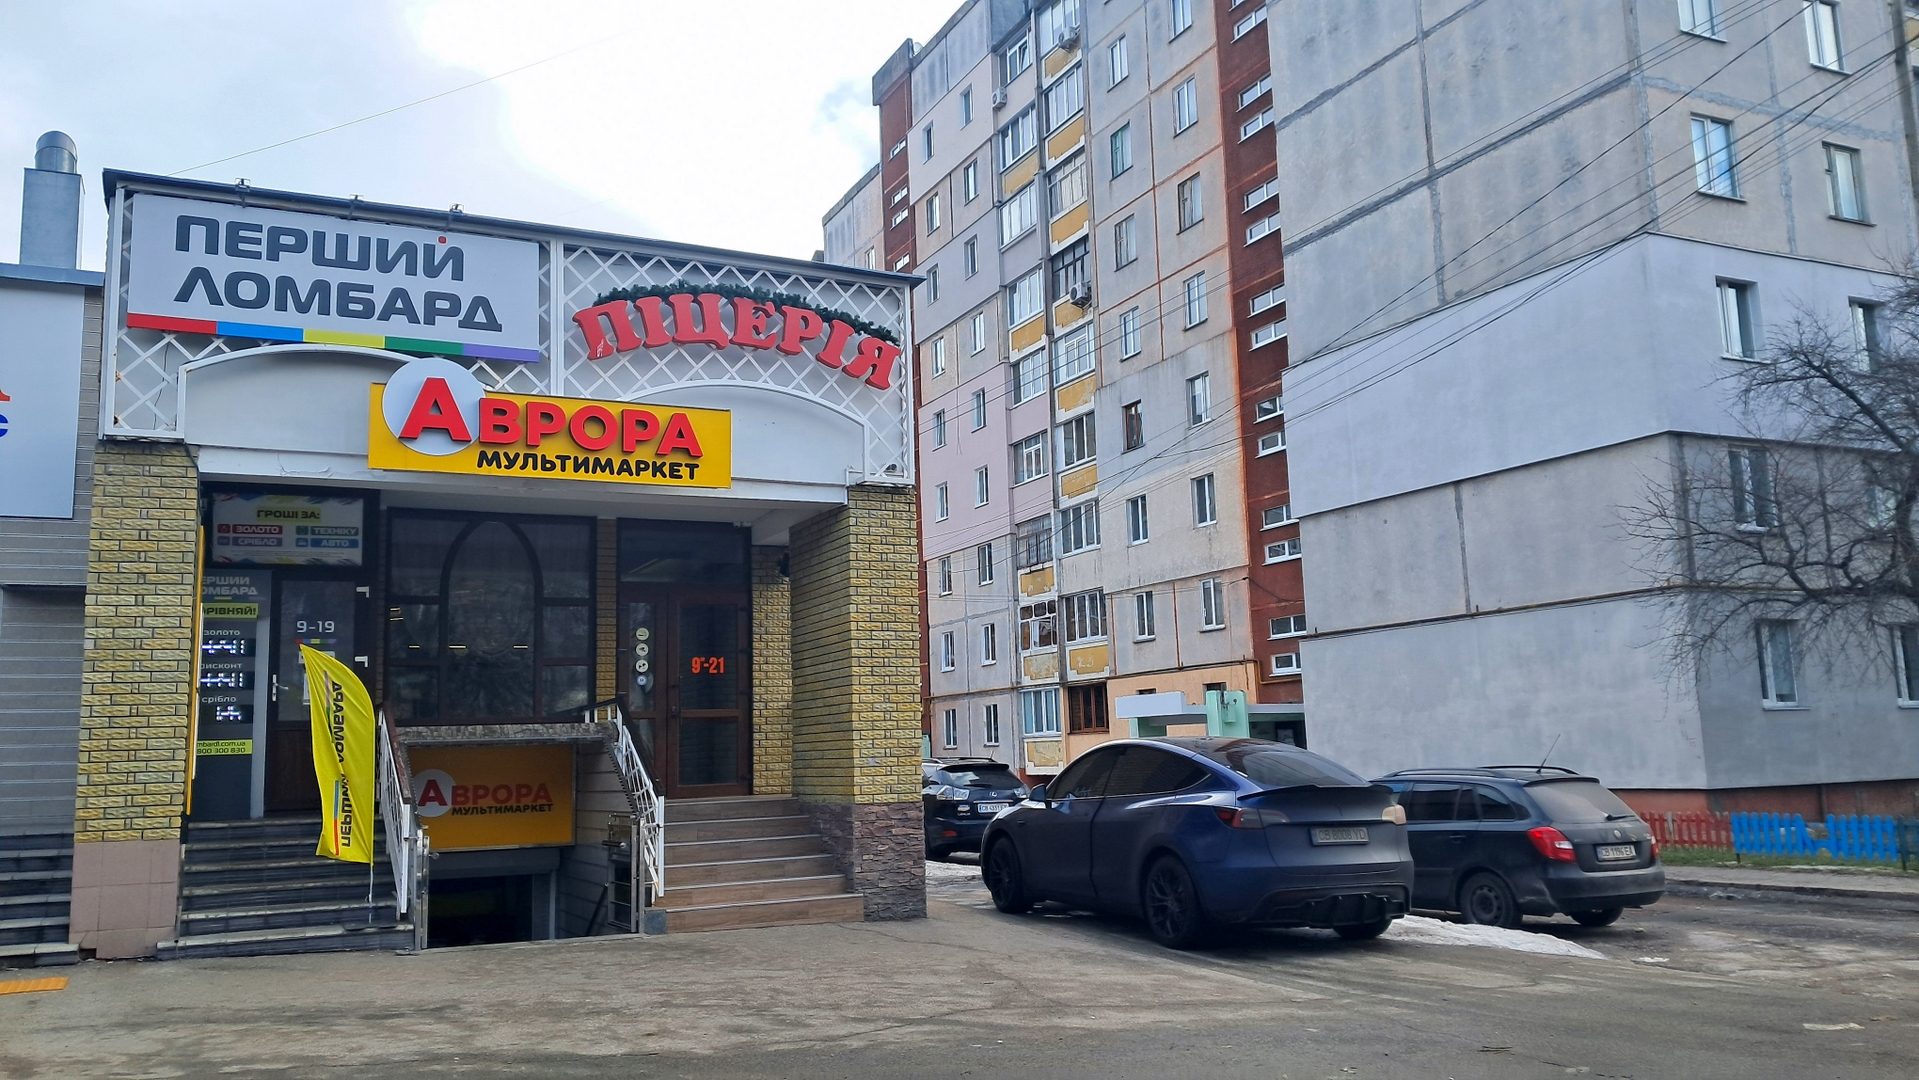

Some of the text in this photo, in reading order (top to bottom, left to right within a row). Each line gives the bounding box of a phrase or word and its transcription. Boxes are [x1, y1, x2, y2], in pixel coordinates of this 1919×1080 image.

[175, 214, 465, 281] ПЕРШИЙ
[173, 266, 502, 332] ЛОМБАРД
[572, 292, 900, 391] ПІЦЕРІЯ
[399, 376, 704, 458] АВРОРА
[477, 449, 699, 480] МУЛЬТИМАРКЕТ
[257, 509, 299, 519] ГРОШІ
[236, 526, 279, 534] ЗОЛОТО
[313, 527, 357, 536] ТЕХНІКУ
[238, 538, 277, 546] СРІБЛО
[320, 538, 350, 547] АВТО
[202, 586, 258, 595] ОМБАРД
[296, 620, 335, 633] 9-19
[201, 695, 237, 704] срібло
[418, 779, 553, 807] АВРОРА
[451, 803, 554, 816] МУЛЬТИМАРКЕТ
